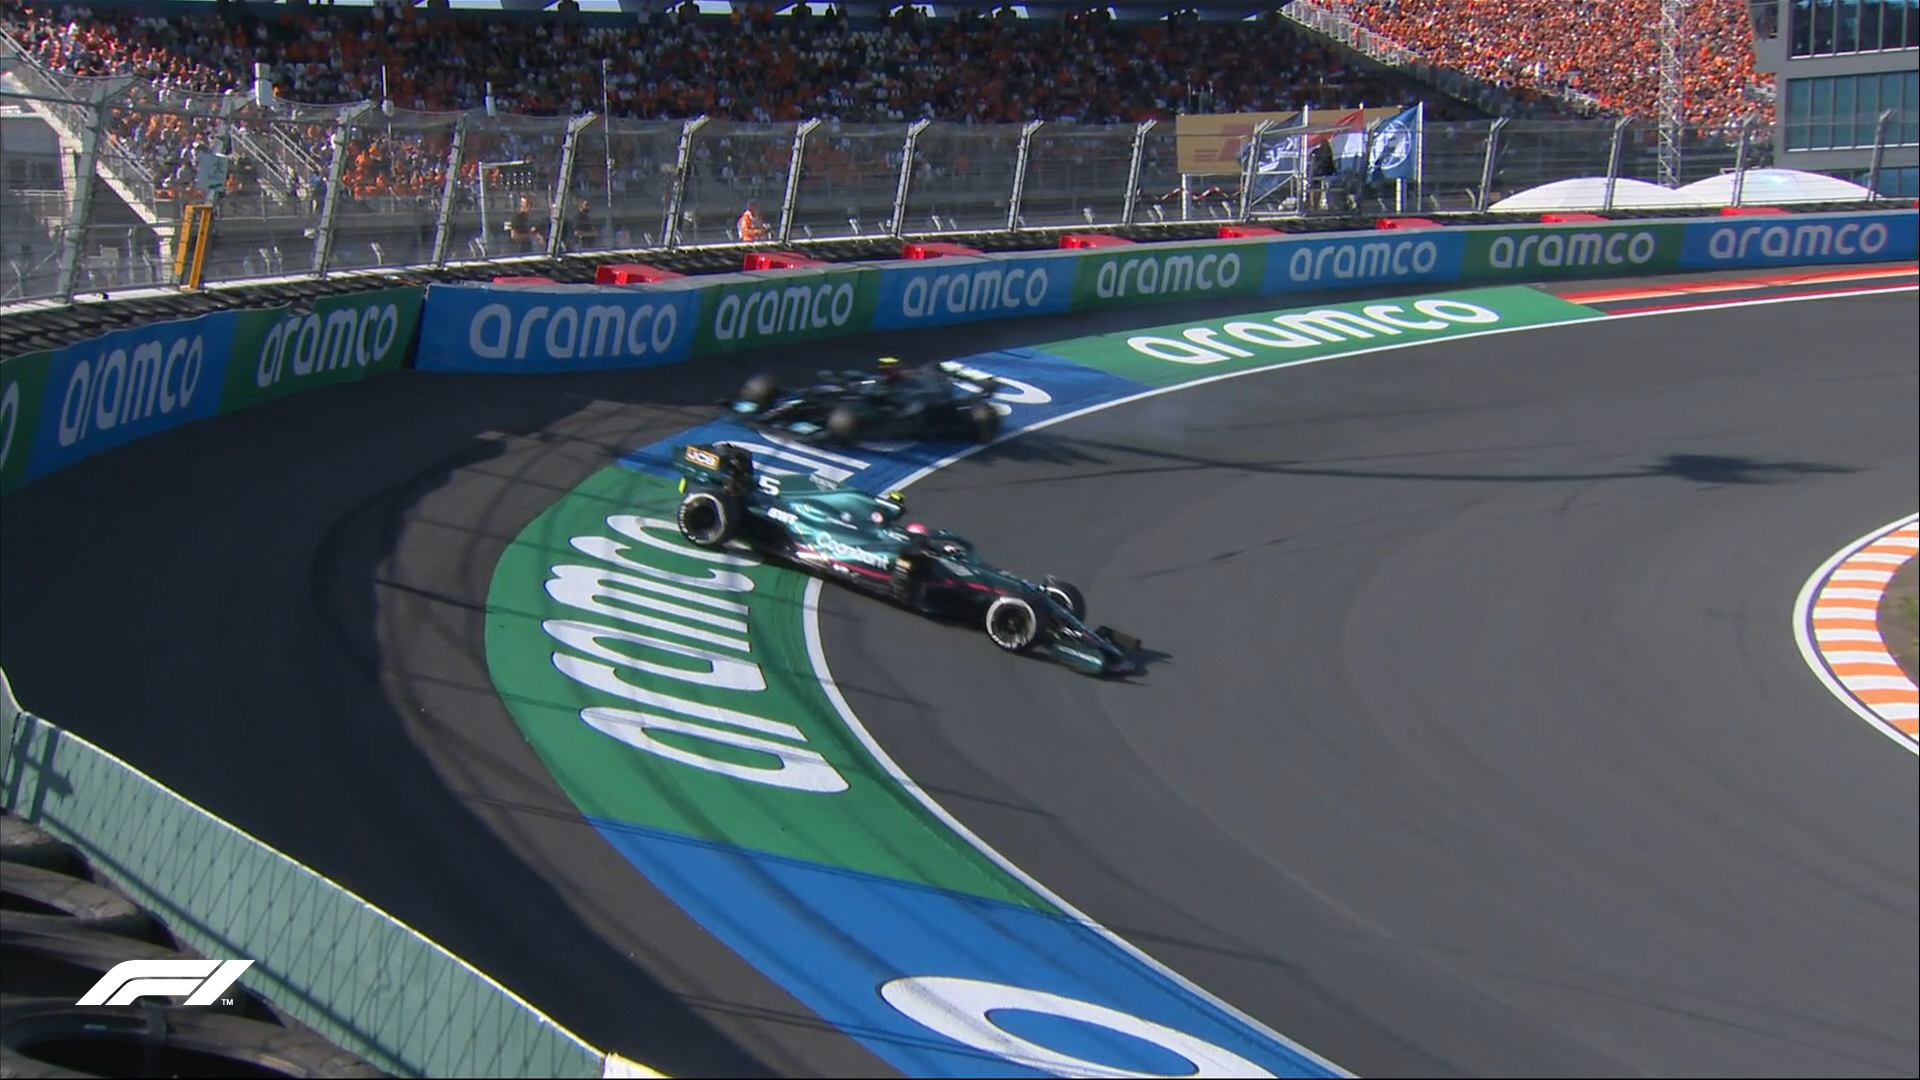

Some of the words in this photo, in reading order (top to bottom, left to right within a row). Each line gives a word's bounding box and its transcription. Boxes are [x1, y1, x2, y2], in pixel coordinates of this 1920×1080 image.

[1289, 239, 1438, 283] aramco
[1489, 231, 1656, 269] aramco
[1708, 222, 1890, 260] aramco
[902, 265, 1050, 318] aramco
[1096, 251, 1241, 299] aramco
[469, 302, 678, 358] aramco
[713, 281, 854, 341] aramco
[1126, 299, 1500, 366] aramco
[256, 302, 398, 388] aramco
[58, 332, 204, 447] aramco
[758, 474, 781, 496] 5
[542, 514, 850, 793] aramco
